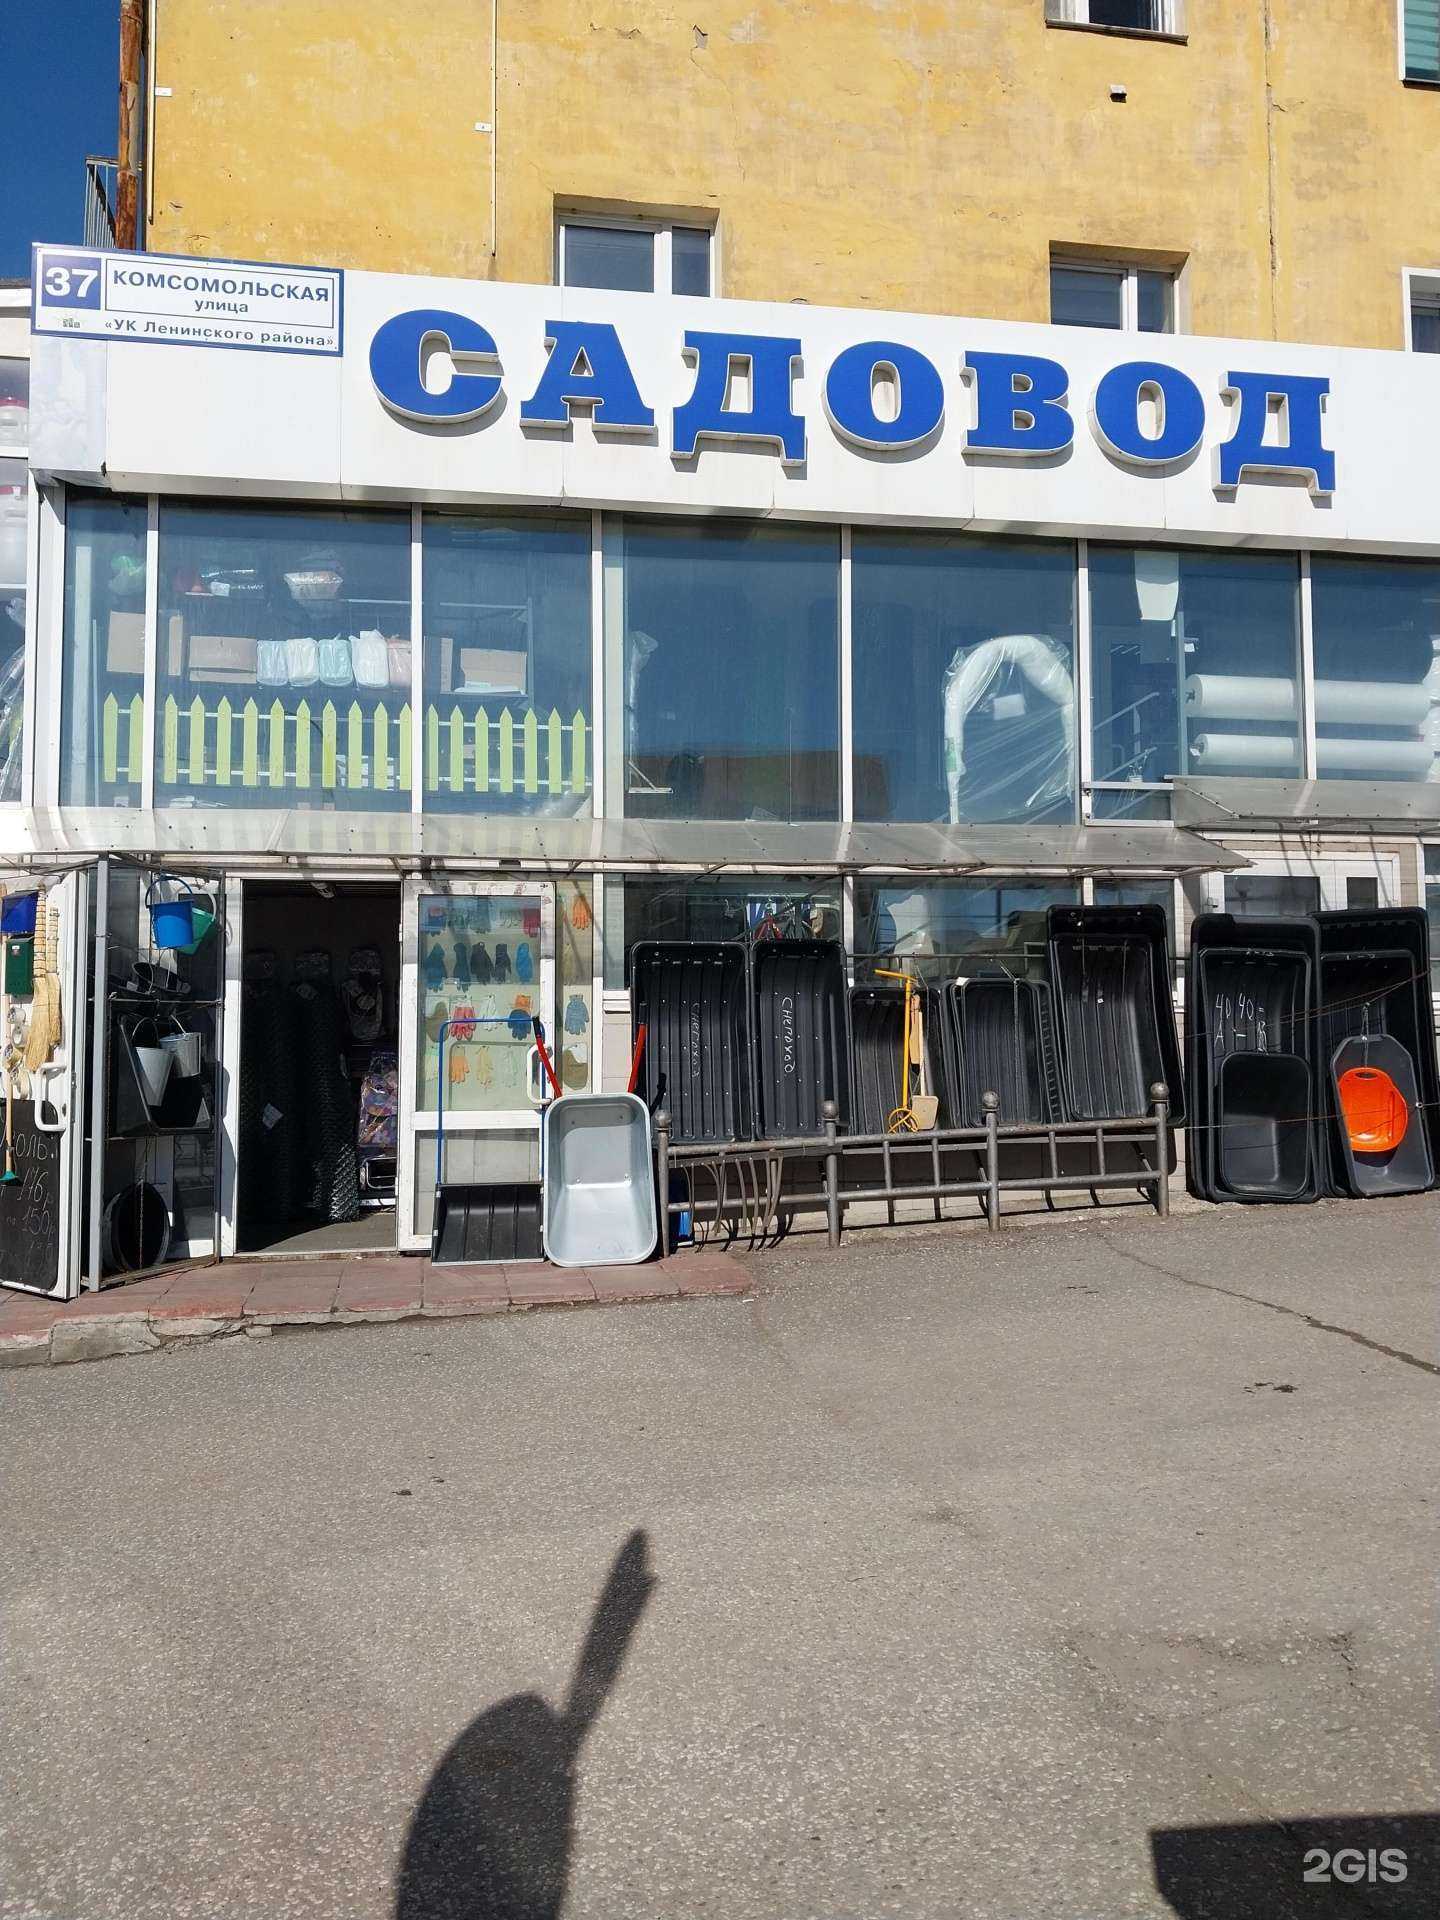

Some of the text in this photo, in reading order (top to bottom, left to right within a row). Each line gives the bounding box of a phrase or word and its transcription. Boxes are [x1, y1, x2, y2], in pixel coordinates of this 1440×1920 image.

[44, 267, 98, 298] 37
[113, 270, 329, 302] КОМСОМОЛЬСКАЯ
[194, 298, 249, 313] улица
[105, 319, 334, 347] «УК Ленинского района»
[369, 309, 1336, 498] САДОВОД
